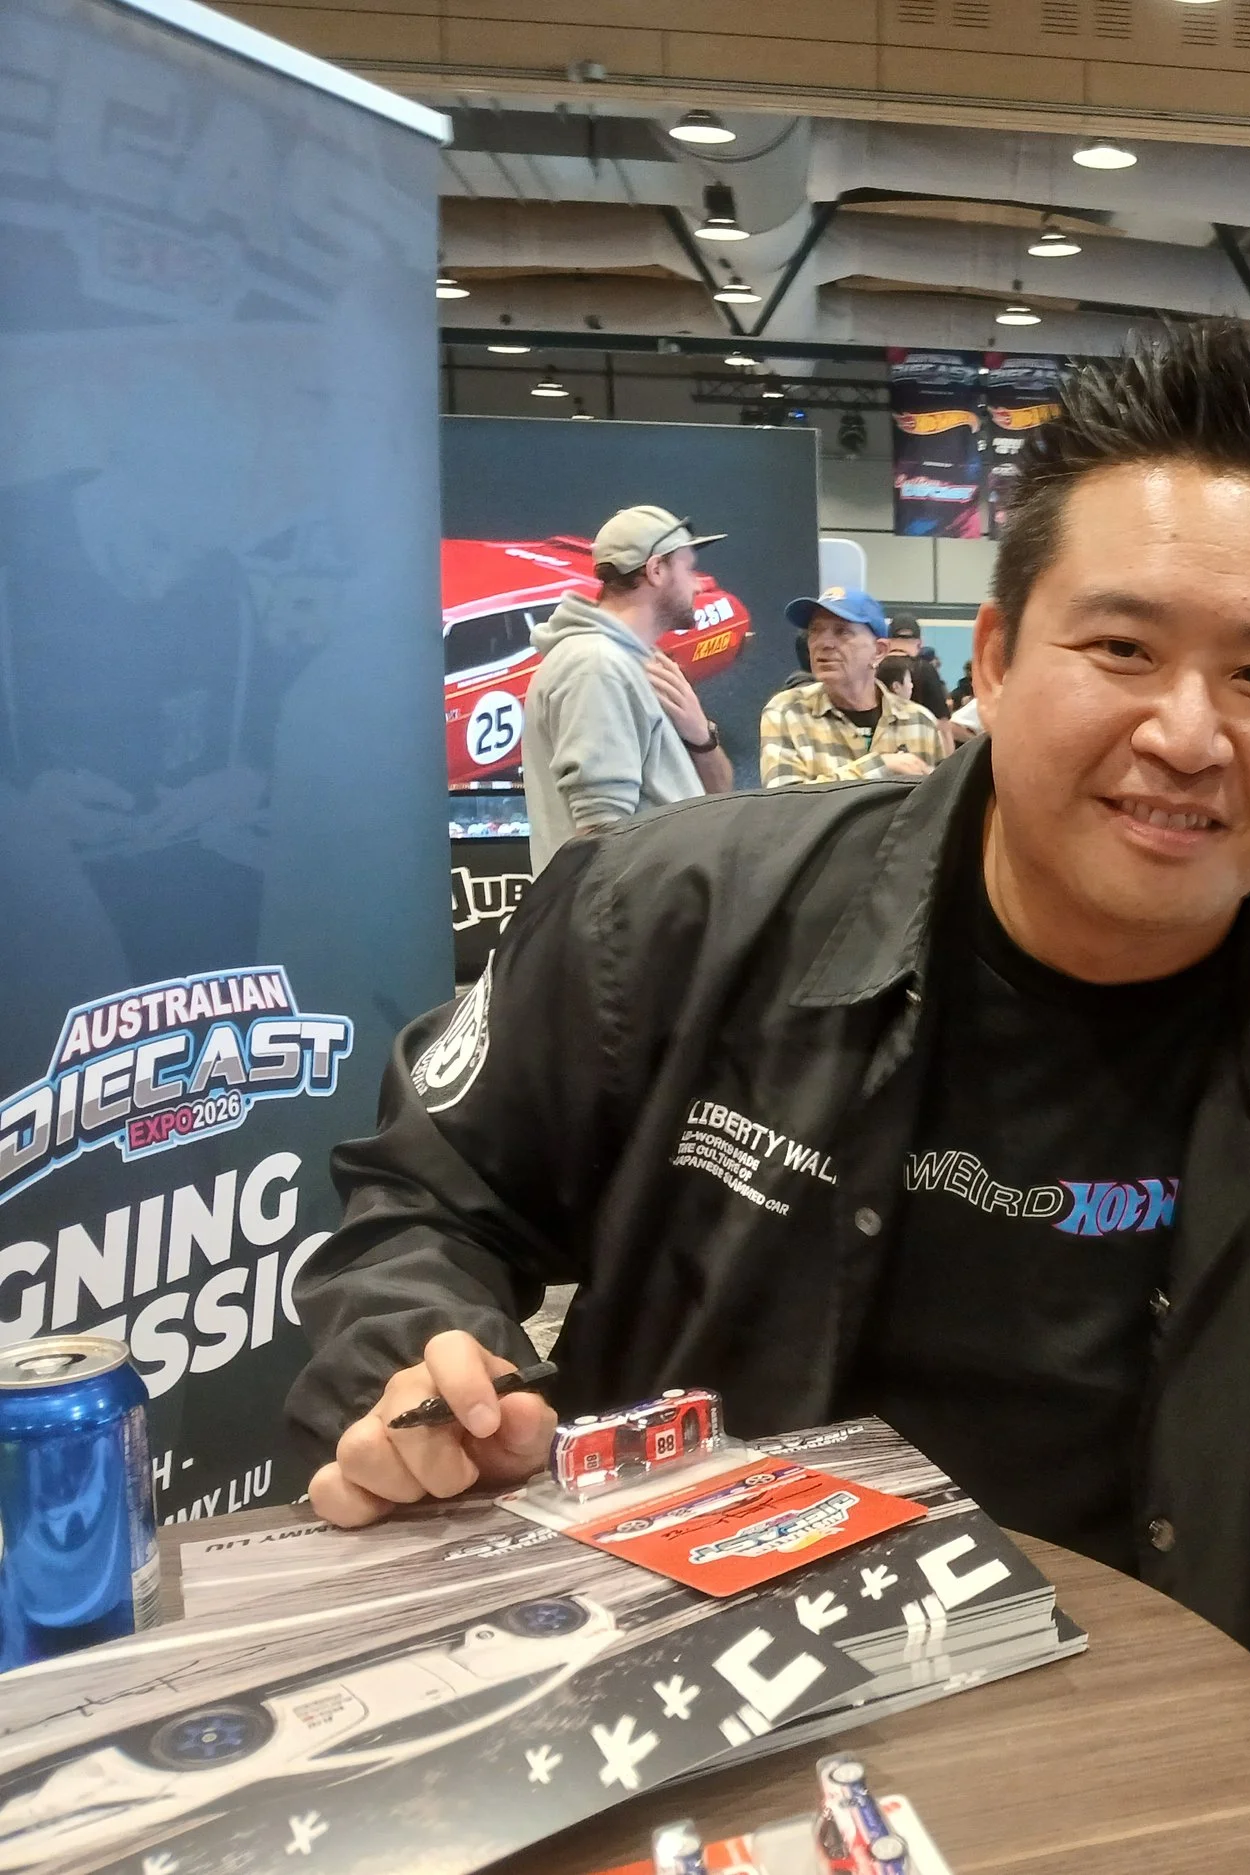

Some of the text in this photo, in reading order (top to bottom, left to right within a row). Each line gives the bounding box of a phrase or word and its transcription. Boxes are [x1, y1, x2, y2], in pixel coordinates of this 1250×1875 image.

[475, 704, 514, 756] 25
[60, 974, 288, 1064] AUSTRALIAN
[0, 1020, 345, 1180] DIECAST
[687, 1100, 838, 1185] LIBERTY WAL
[764, 1199, 790, 1217] CAR
[904, 1150, 1065, 1218] WEIRD
[75, 1231, 334, 1400] SSI
[657, 1434, 675, 1455] 88
[228, 1459, 273, 1514] LIU
